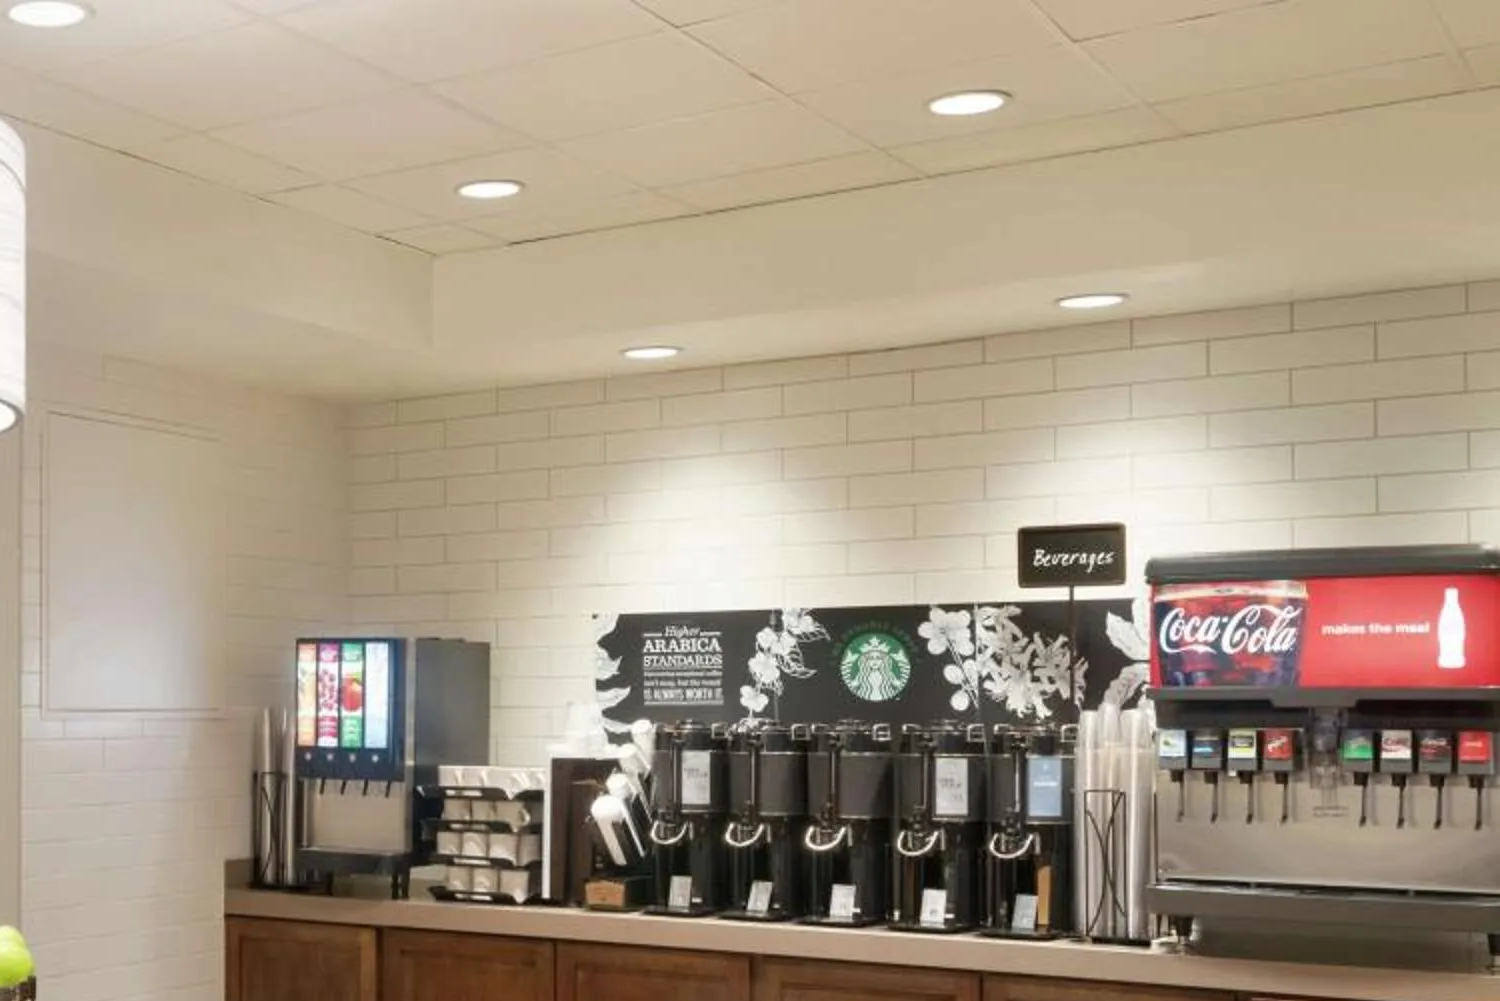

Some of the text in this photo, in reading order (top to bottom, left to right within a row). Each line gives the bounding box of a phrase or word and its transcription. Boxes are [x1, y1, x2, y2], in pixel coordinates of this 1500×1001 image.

[1033, 548, 1115, 573] Beverages
[1160, 604, 1302, 655] Coca-Cola
[1368, 623, 1392, 634] the
[643, 637, 722, 653] ARABICA
[643, 654, 723, 667] STANDARDS
